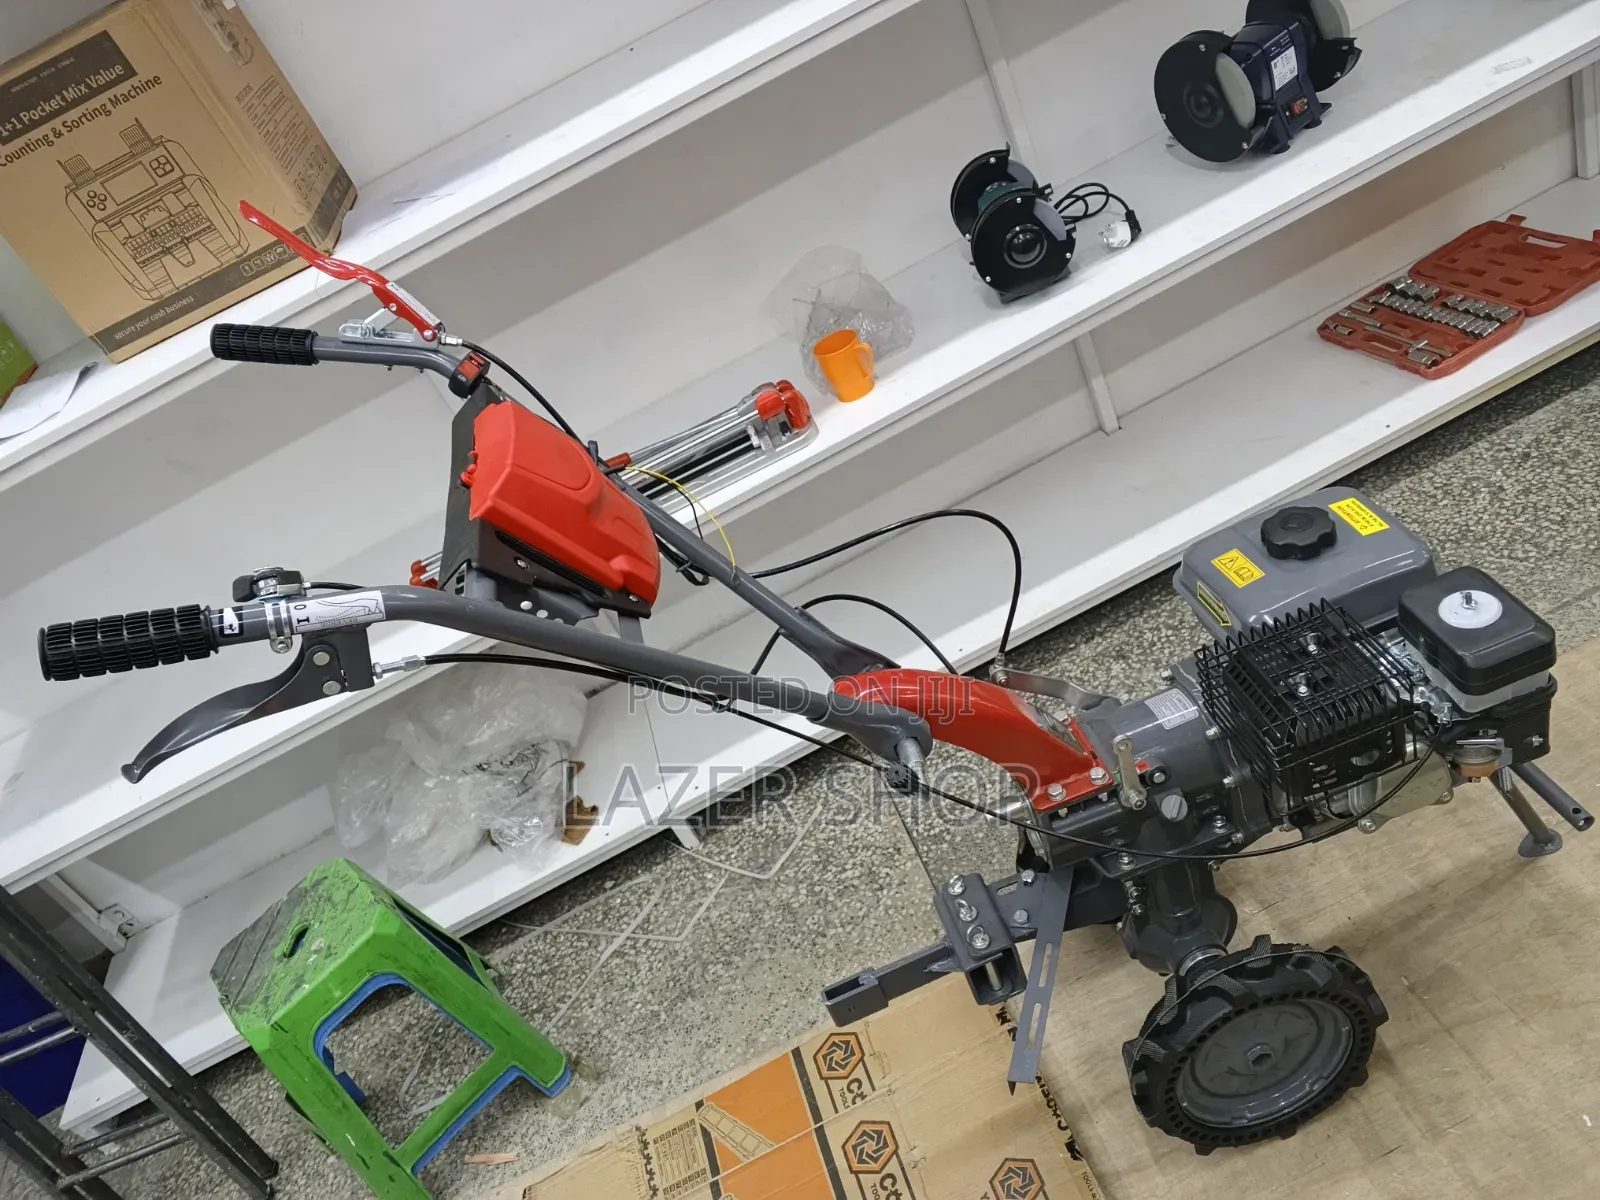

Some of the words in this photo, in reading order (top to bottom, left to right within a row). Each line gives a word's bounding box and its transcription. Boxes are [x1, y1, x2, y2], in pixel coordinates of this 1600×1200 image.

[19, 94, 66, 125] Pocket
[62, 83, 90, 102] Mix
[85, 63, 125, 88] Value
[50, 127, 64, 139] &
[62, 103, 112, 133] Sorting
[108, 75, 162, 109] Machine
[114, 325, 135, 340] secure
[135, 317, 151, 331] your
[150, 309, 166, 321] cash
[165, 295, 194, 314] business
